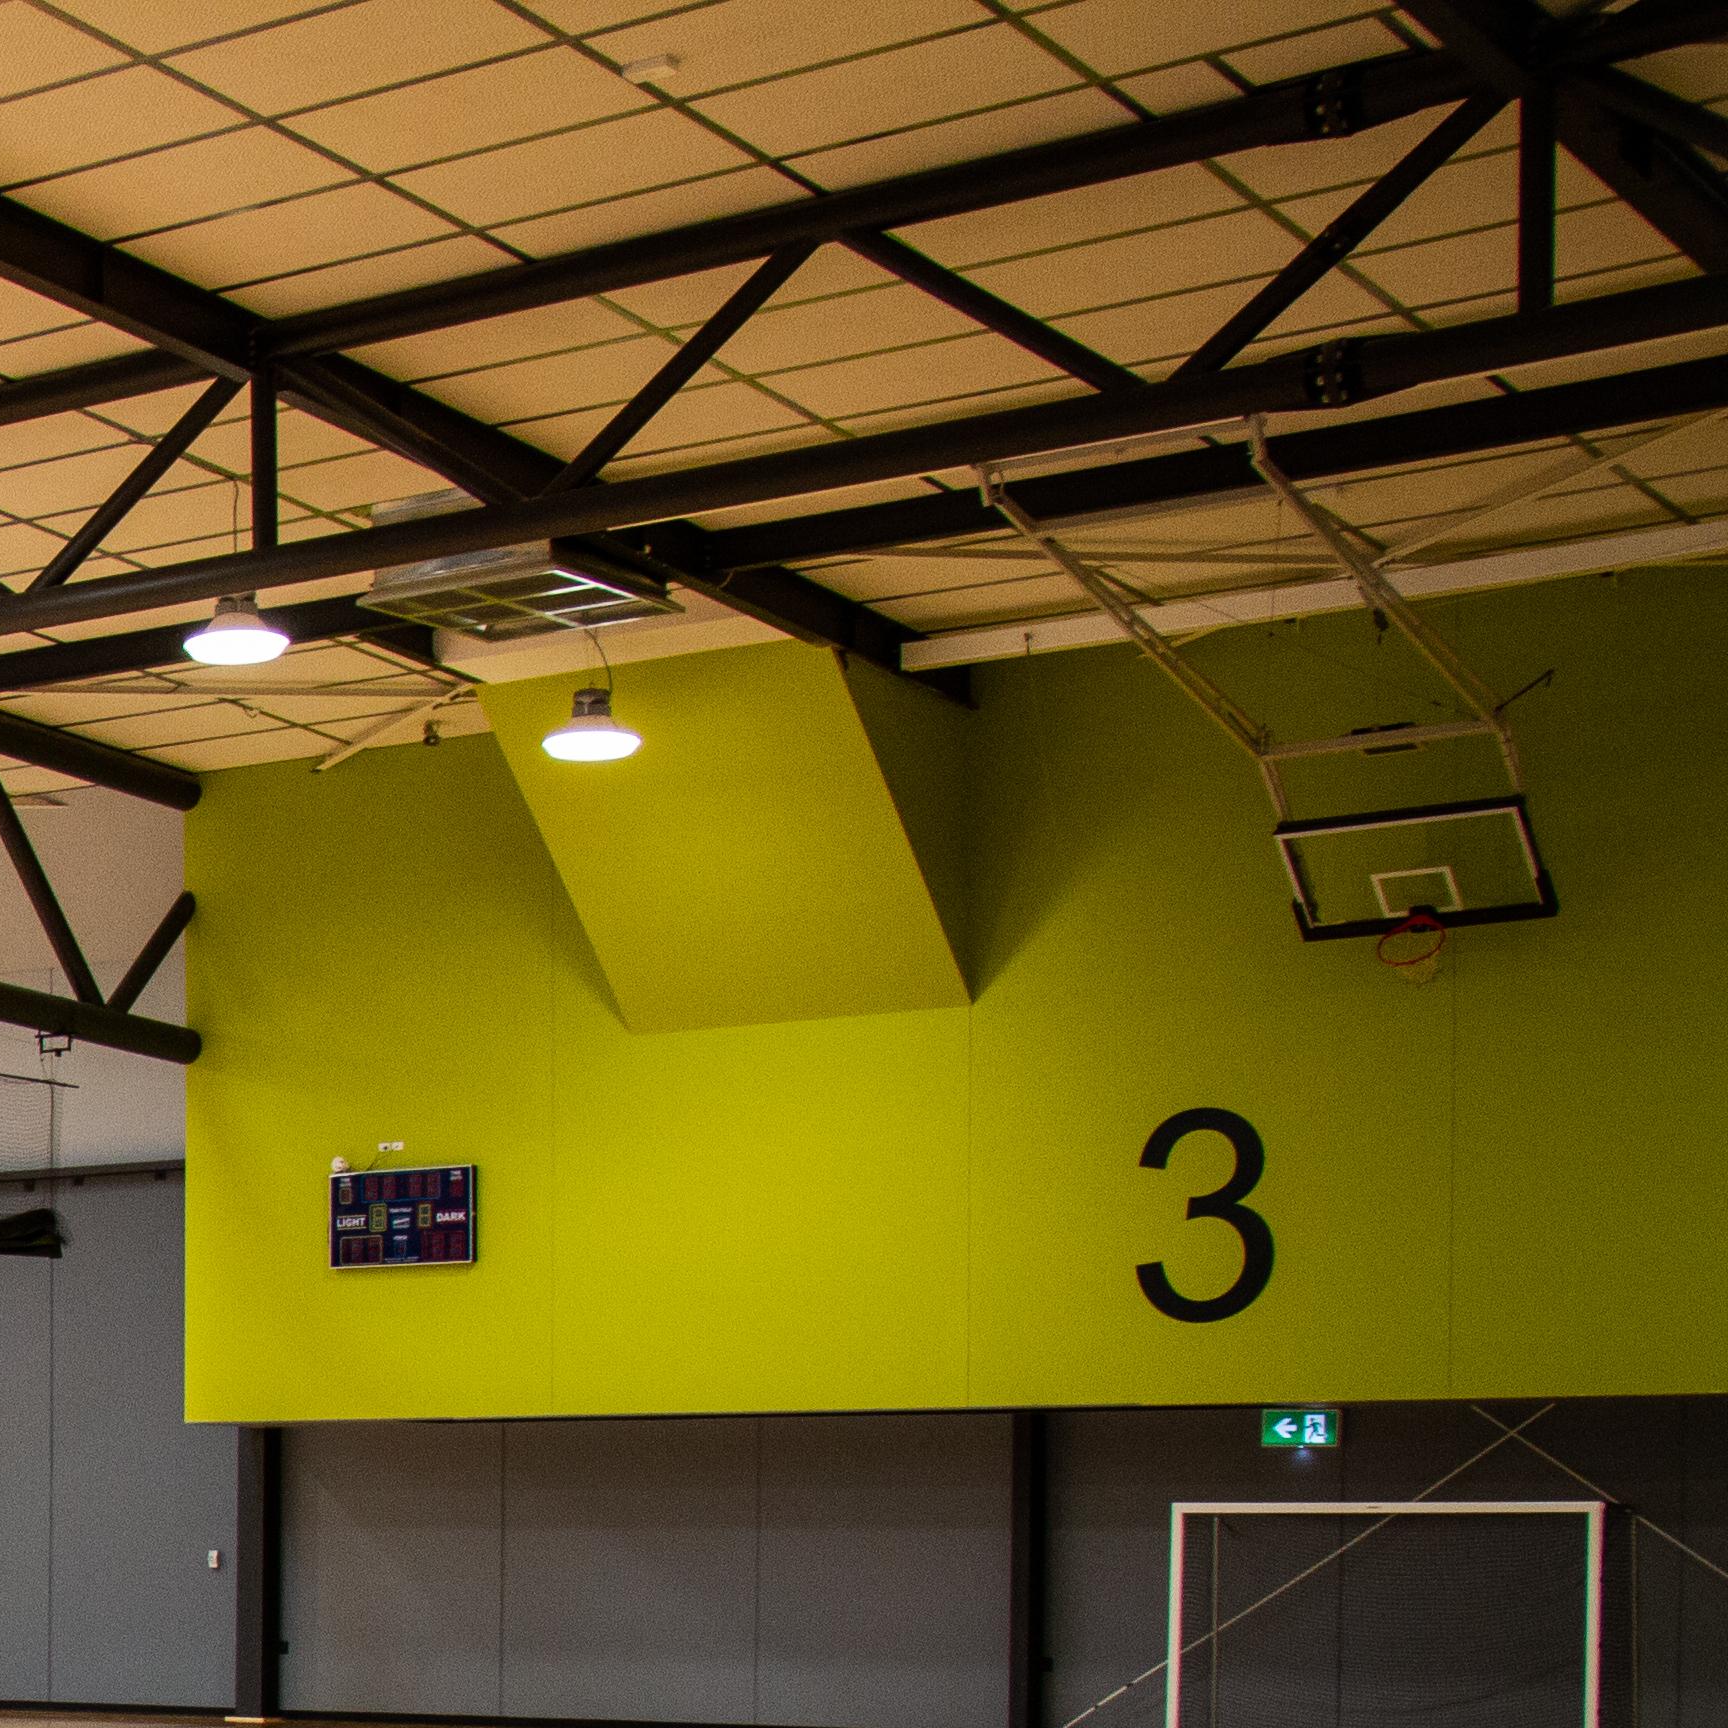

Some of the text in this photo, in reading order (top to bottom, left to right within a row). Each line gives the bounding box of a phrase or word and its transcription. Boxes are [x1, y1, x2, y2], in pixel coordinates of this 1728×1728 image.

[336, 1211, 466, 1229] LIGHT DARK
[1136, 1106, 1275, 1324] 3
